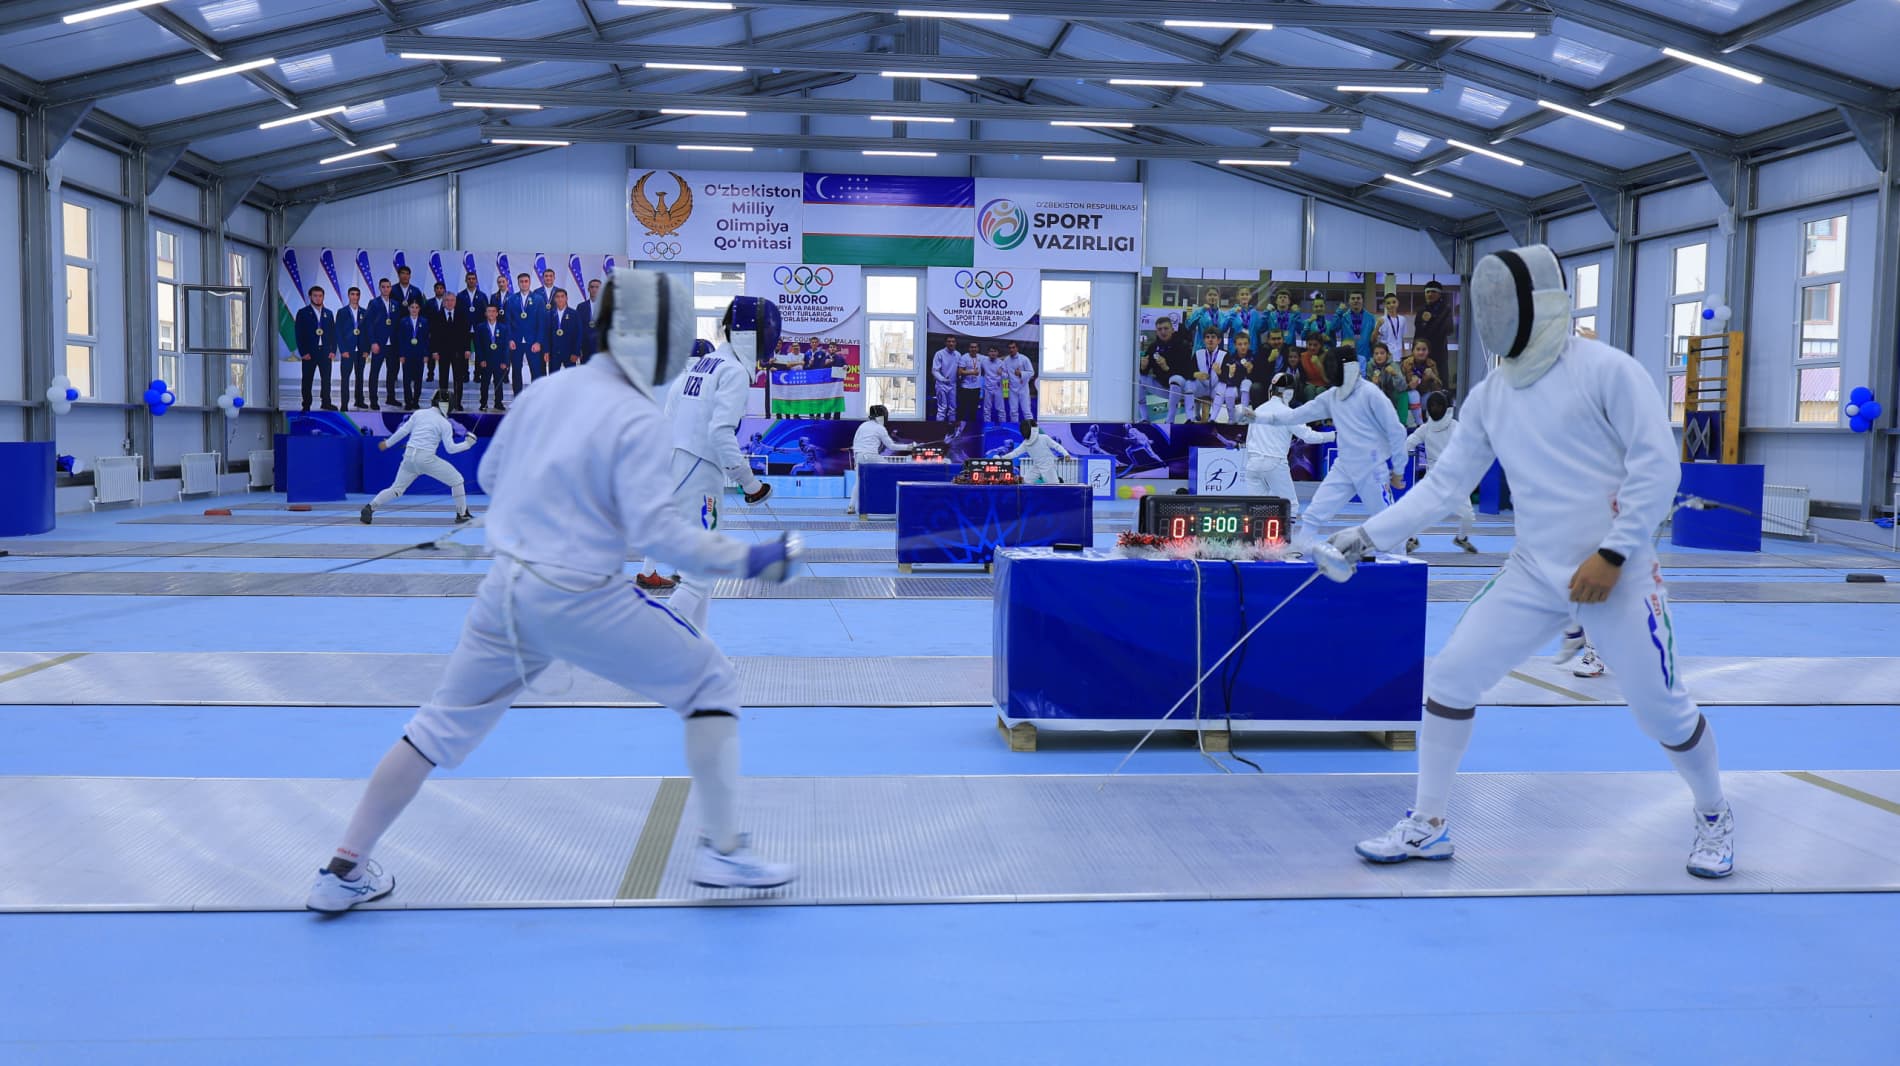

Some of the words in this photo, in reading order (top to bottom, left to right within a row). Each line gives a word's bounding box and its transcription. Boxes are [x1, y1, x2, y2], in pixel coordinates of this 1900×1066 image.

[704, 184, 801, 198] O'zbekiston
[732, 201, 775, 218] Milliy
[1086, 203, 1138, 211] RESPUBLIKASI
[716, 219, 789, 235] Olimpiya
[1033, 213, 1103, 230] SPORT
[714, 236, 792, 251] Qo'mitasi
[1033, 234, 1135, 252] VAZIRLIGI
[779, 294, 828, 305] BUXORO
[959, 299, 1008, 309] BUXORO
[683, 375, 703, 397] UZB
[1173, 518, 1185, 538] 0
[1202, 516, 1237, 533] 3:00
[1267, 519, 1279, 540] 0
